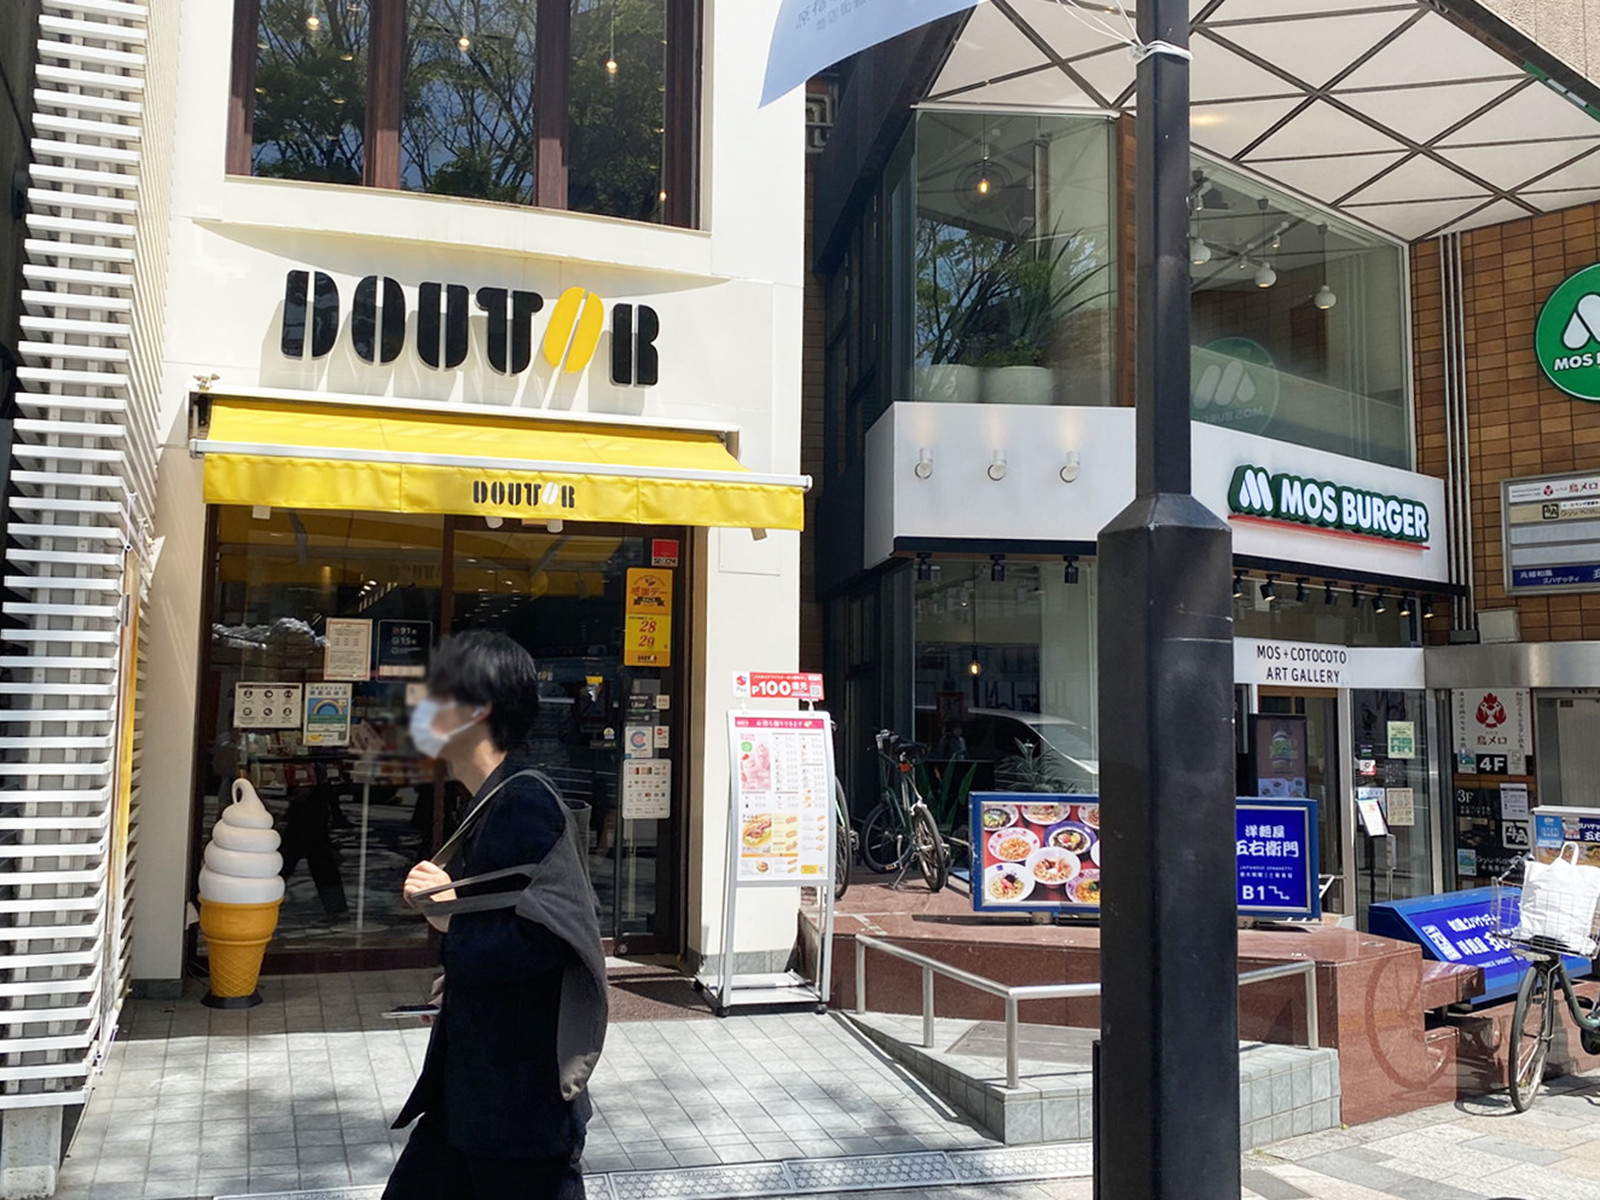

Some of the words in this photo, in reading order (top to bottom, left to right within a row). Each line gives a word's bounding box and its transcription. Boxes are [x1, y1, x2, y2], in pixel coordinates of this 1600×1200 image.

[280, 269, 660, 386] DOUTOR
[1554, 353, 1594, 371] MOS
[473, 479, 575, 509] DOUTOR
[1281, 477, 1338, 524] MOS
[1341, 490, 1427, 539] BURGER
[639, 620, 657, 633] 28
[638, 636, 656, 647] 29
[1266, 667, 1288, 681] ART
[1291, 668, 1341, 684] GALLERY
[1480, 757, 1505, 772] 4F
[1457, 789, 1474, 803] 3F
[1243, 885, 1265, 900] B1
